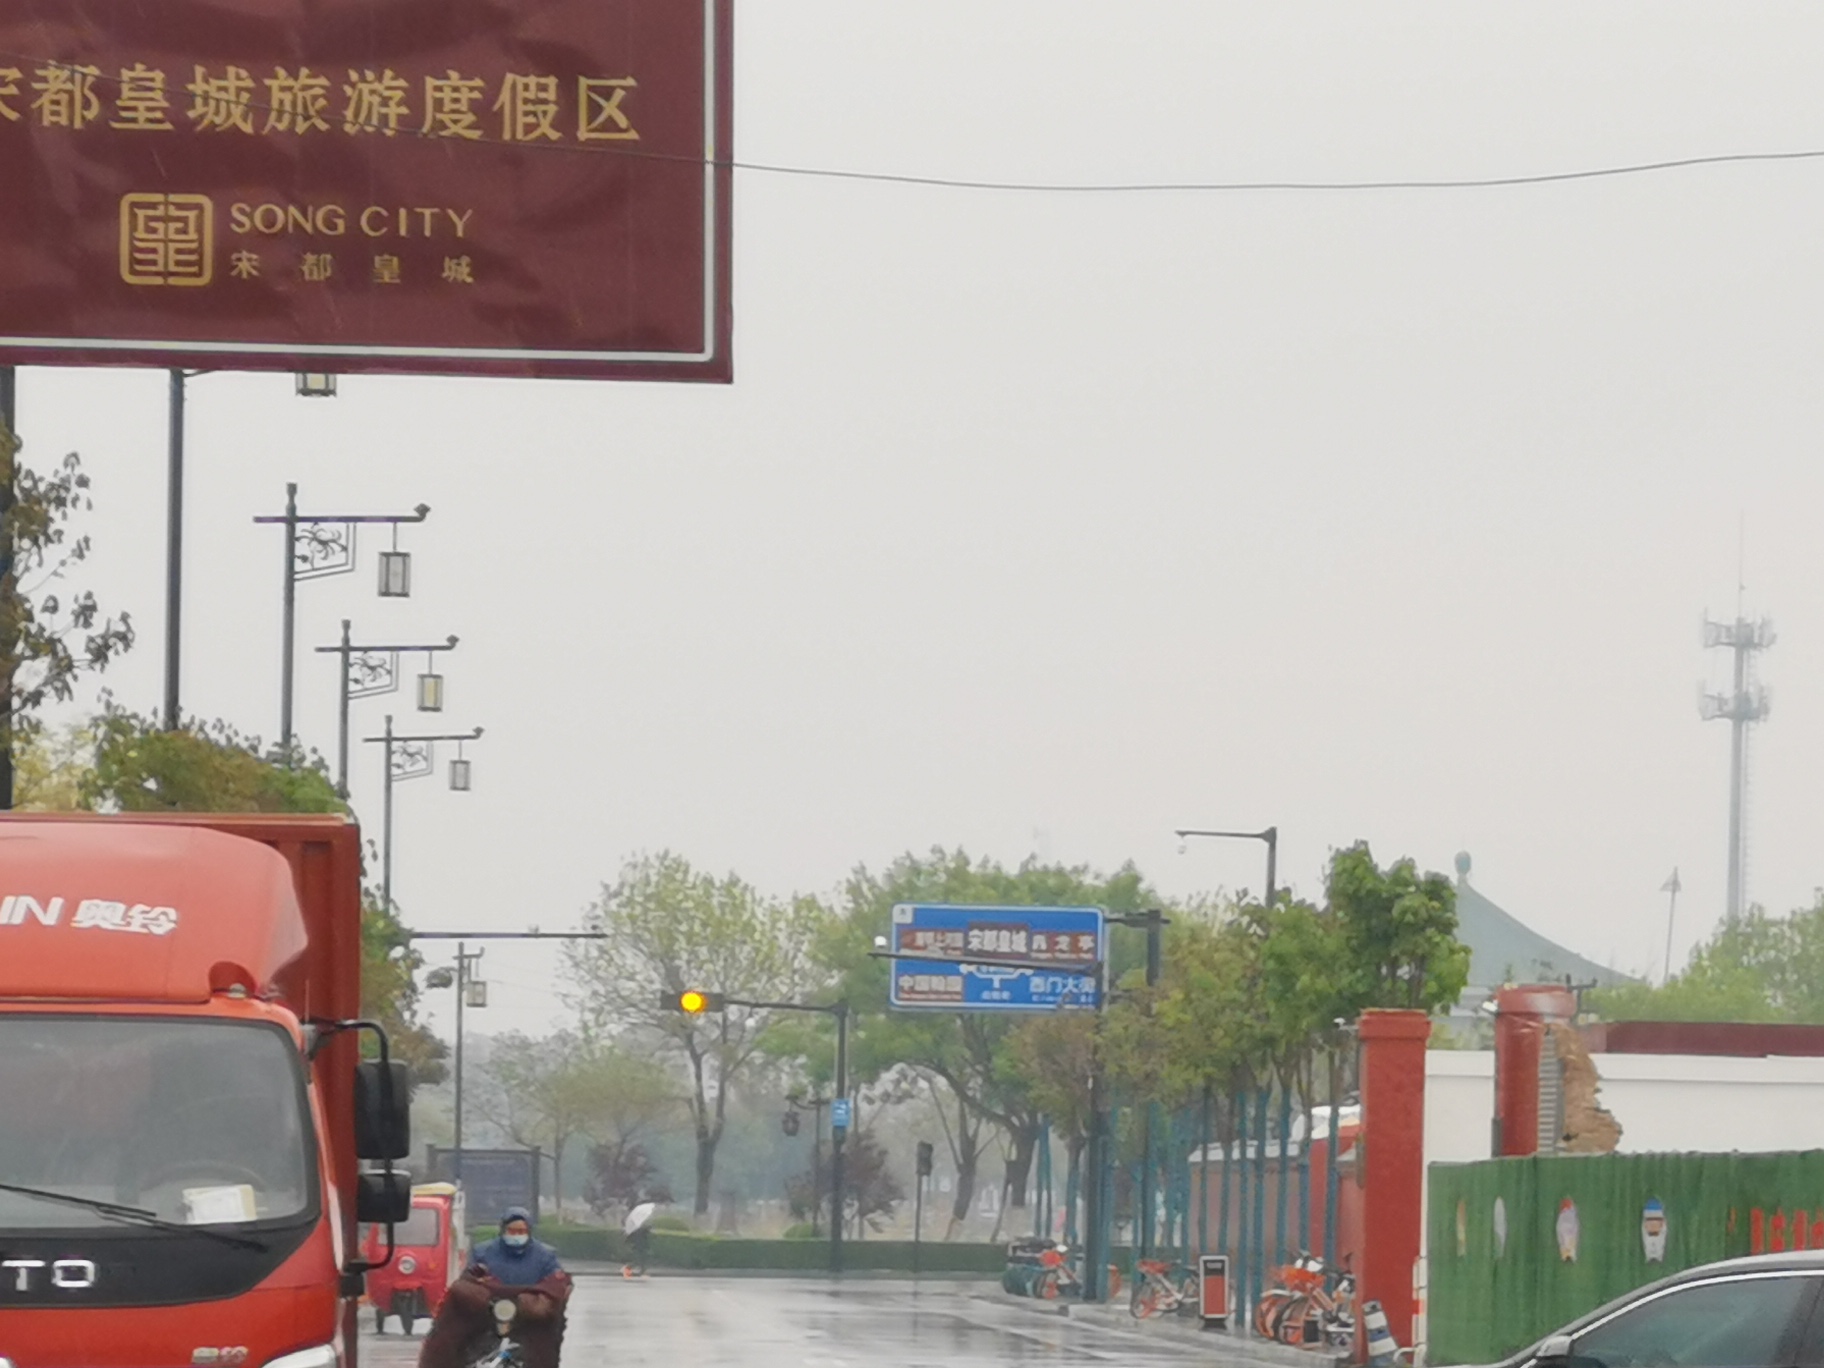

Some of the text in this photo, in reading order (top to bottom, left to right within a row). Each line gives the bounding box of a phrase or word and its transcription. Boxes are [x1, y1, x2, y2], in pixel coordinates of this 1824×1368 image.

[230, 203, 473, 240] SONG CITY
[231, 250, 474, 284] 宋都皇城
[70, 898, 178, 935] 奥铃
